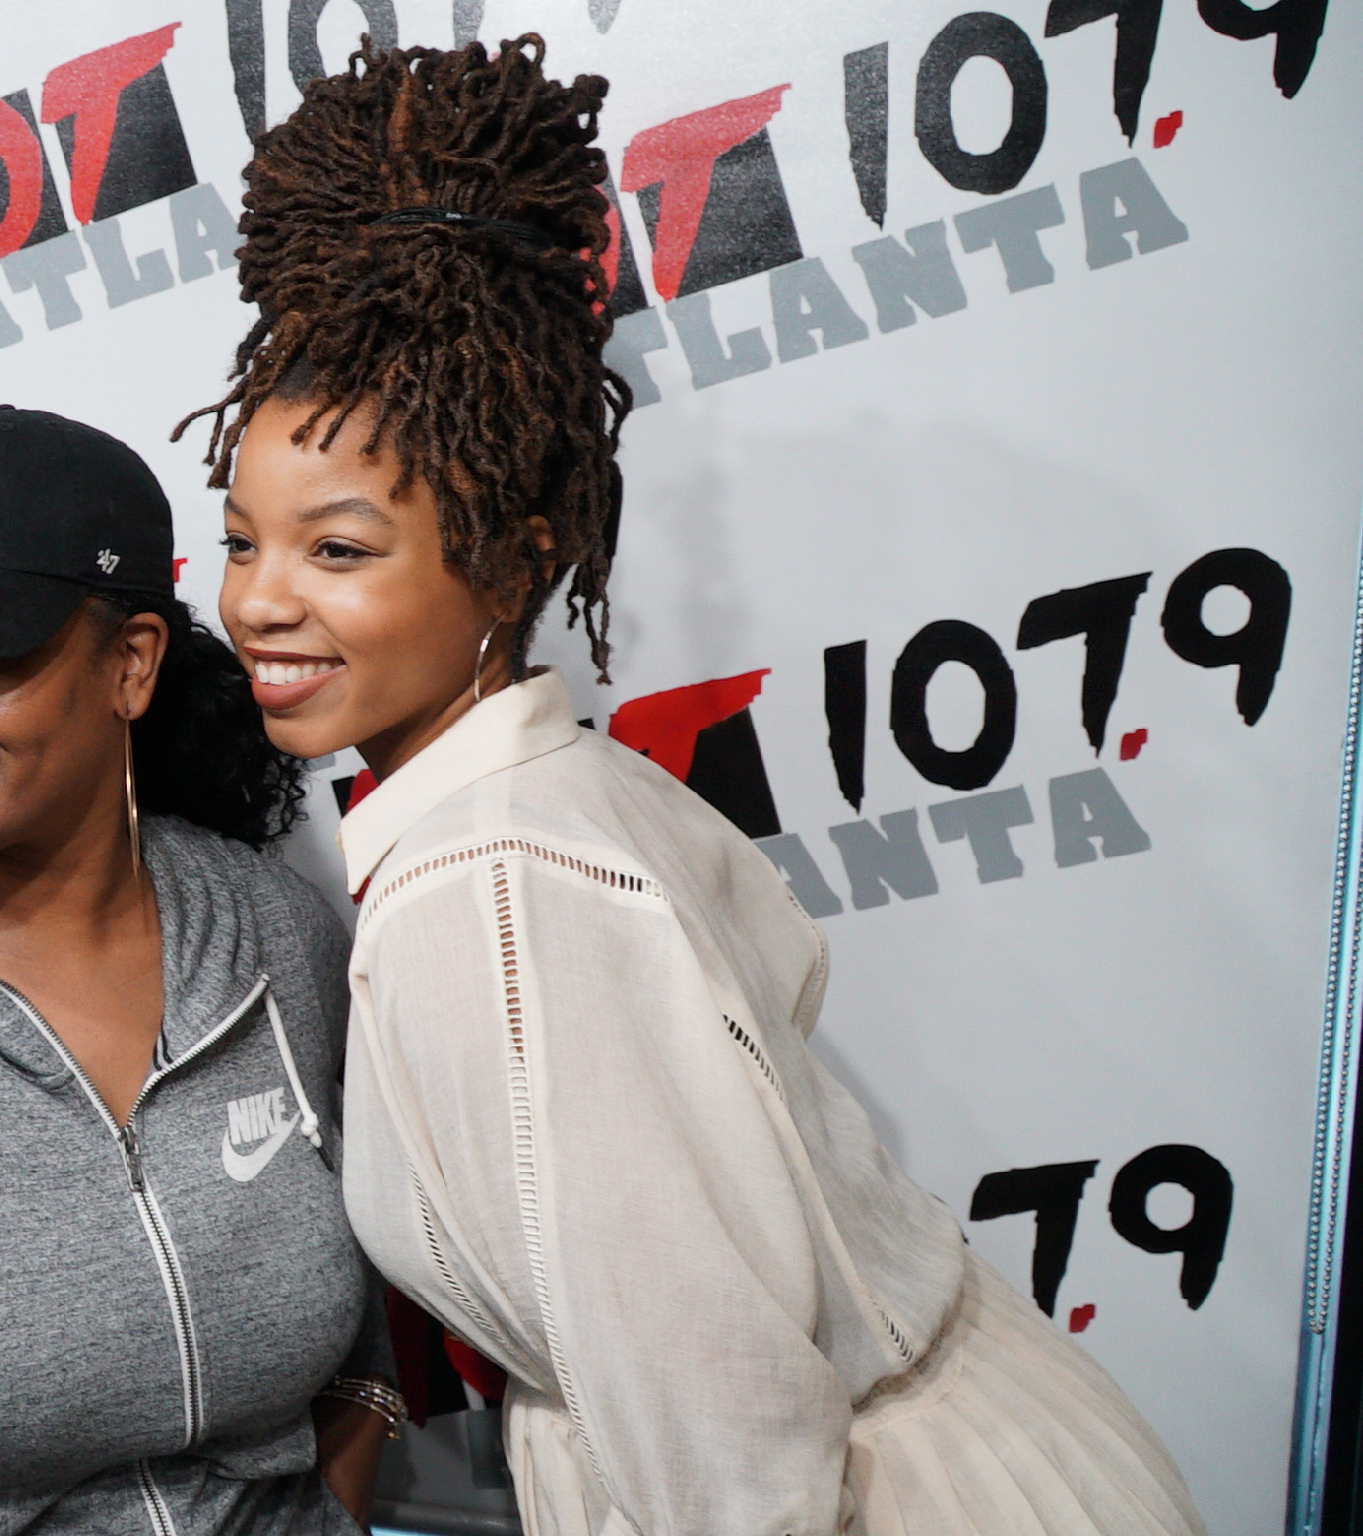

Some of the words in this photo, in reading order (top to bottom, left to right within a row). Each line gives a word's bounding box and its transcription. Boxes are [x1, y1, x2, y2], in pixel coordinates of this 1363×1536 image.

[602, 157, 1189, 411] TLANTA
[824, 547, 1292, 815] 107.9
[754, 767, 1151, 919] ANTA
[227, 1086, 289, 1146] NIKE
[969, 1144, 1234, 1333] 7.9
